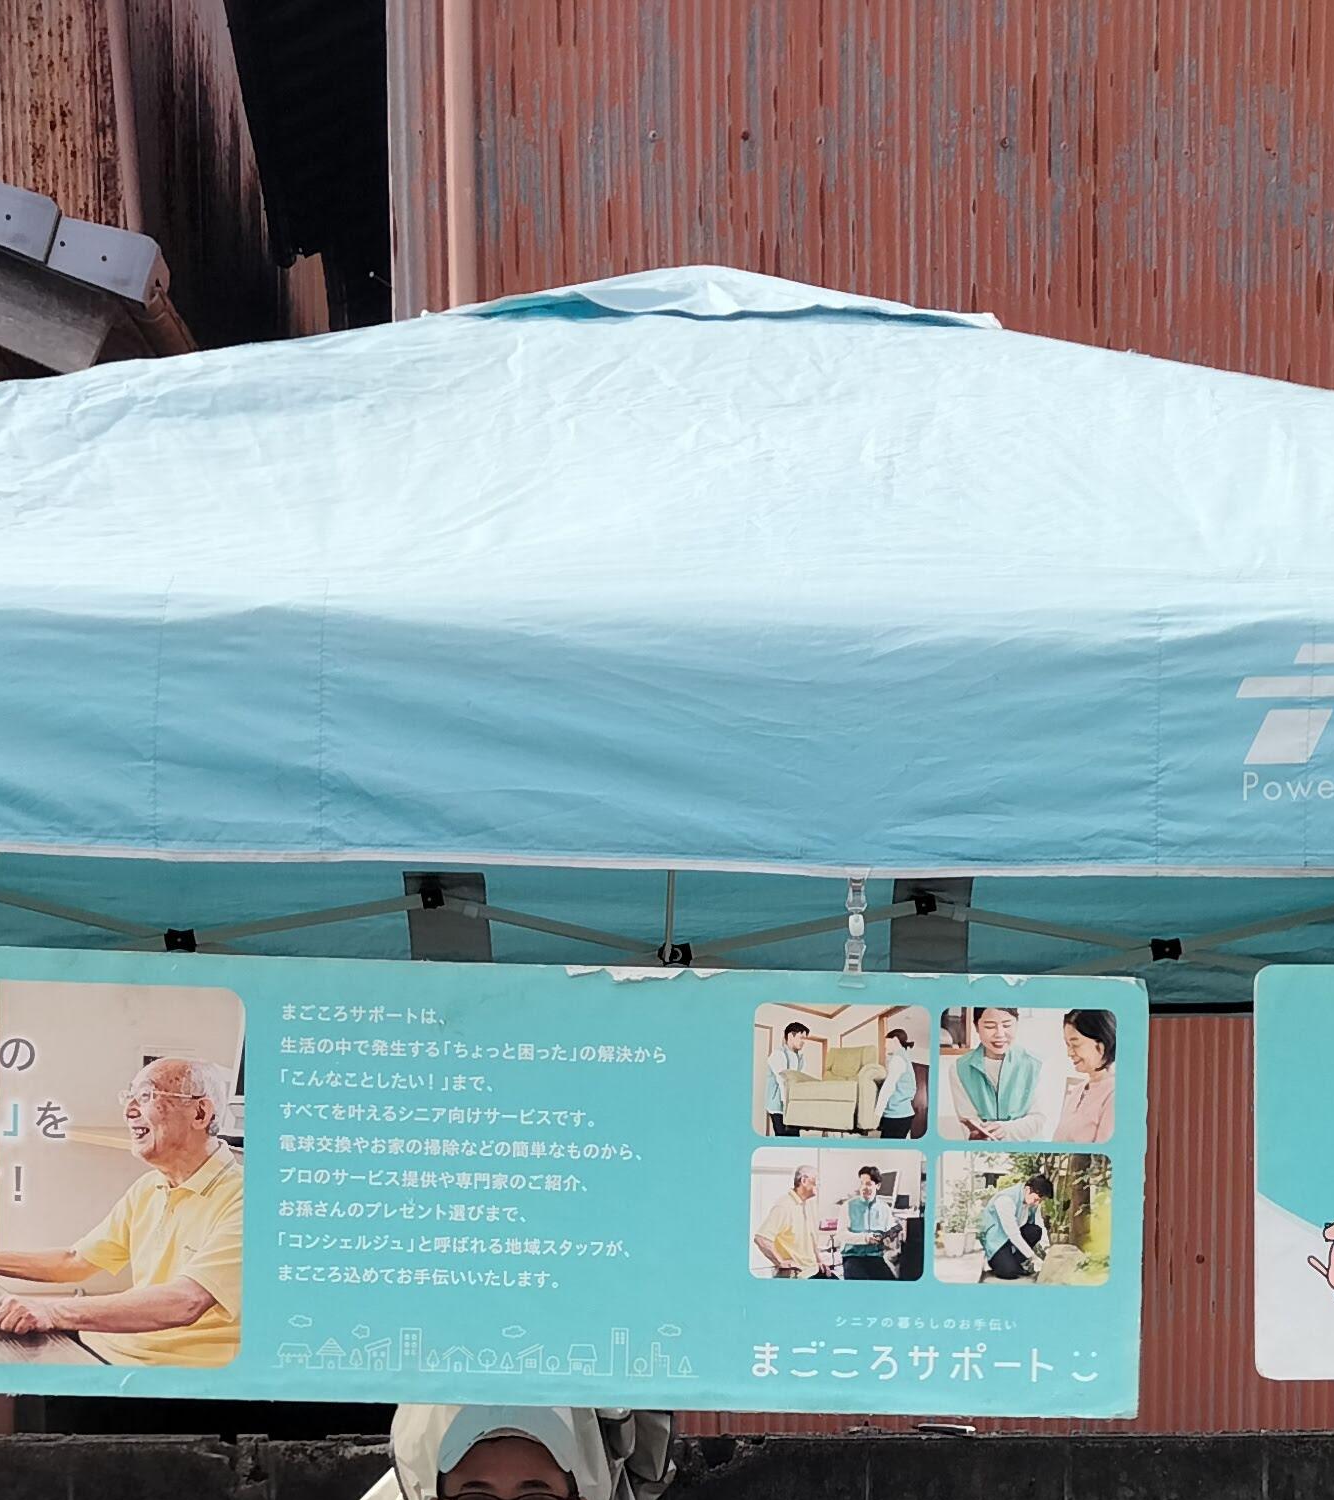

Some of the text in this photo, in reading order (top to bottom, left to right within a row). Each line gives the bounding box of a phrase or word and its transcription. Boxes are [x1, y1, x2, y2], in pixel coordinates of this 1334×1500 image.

[282, 1004, 445, 1025] まごころサポートは、
[280, 1037, 667, 1063] 生活の中で発生する「ちょっと困った」の解決から
[279, 1102, 595, 1127] すべてを叶えるシニア向けサービスです。
[279, 1135, 641, 1160] 電球交換やお家の掃除などの簡単なものから、
[279, 1168, 587, 1191] プロのサービス提供や専門家のご紹介、
[278, 1200, 527, 1222] お孫さんのプレゼント選びまで、
[278, 1232, 631, 1257] 「コンシェルジュ」と呼ばれる地域スタッフが、
[278, 1265, 560, 1288] まごころ込めてお手伝いいたします。
[835, 1316, 1017, 1331] シニアの暮らしのお手伝い
[752, 1342, 1054, 1382] まごころサポート
